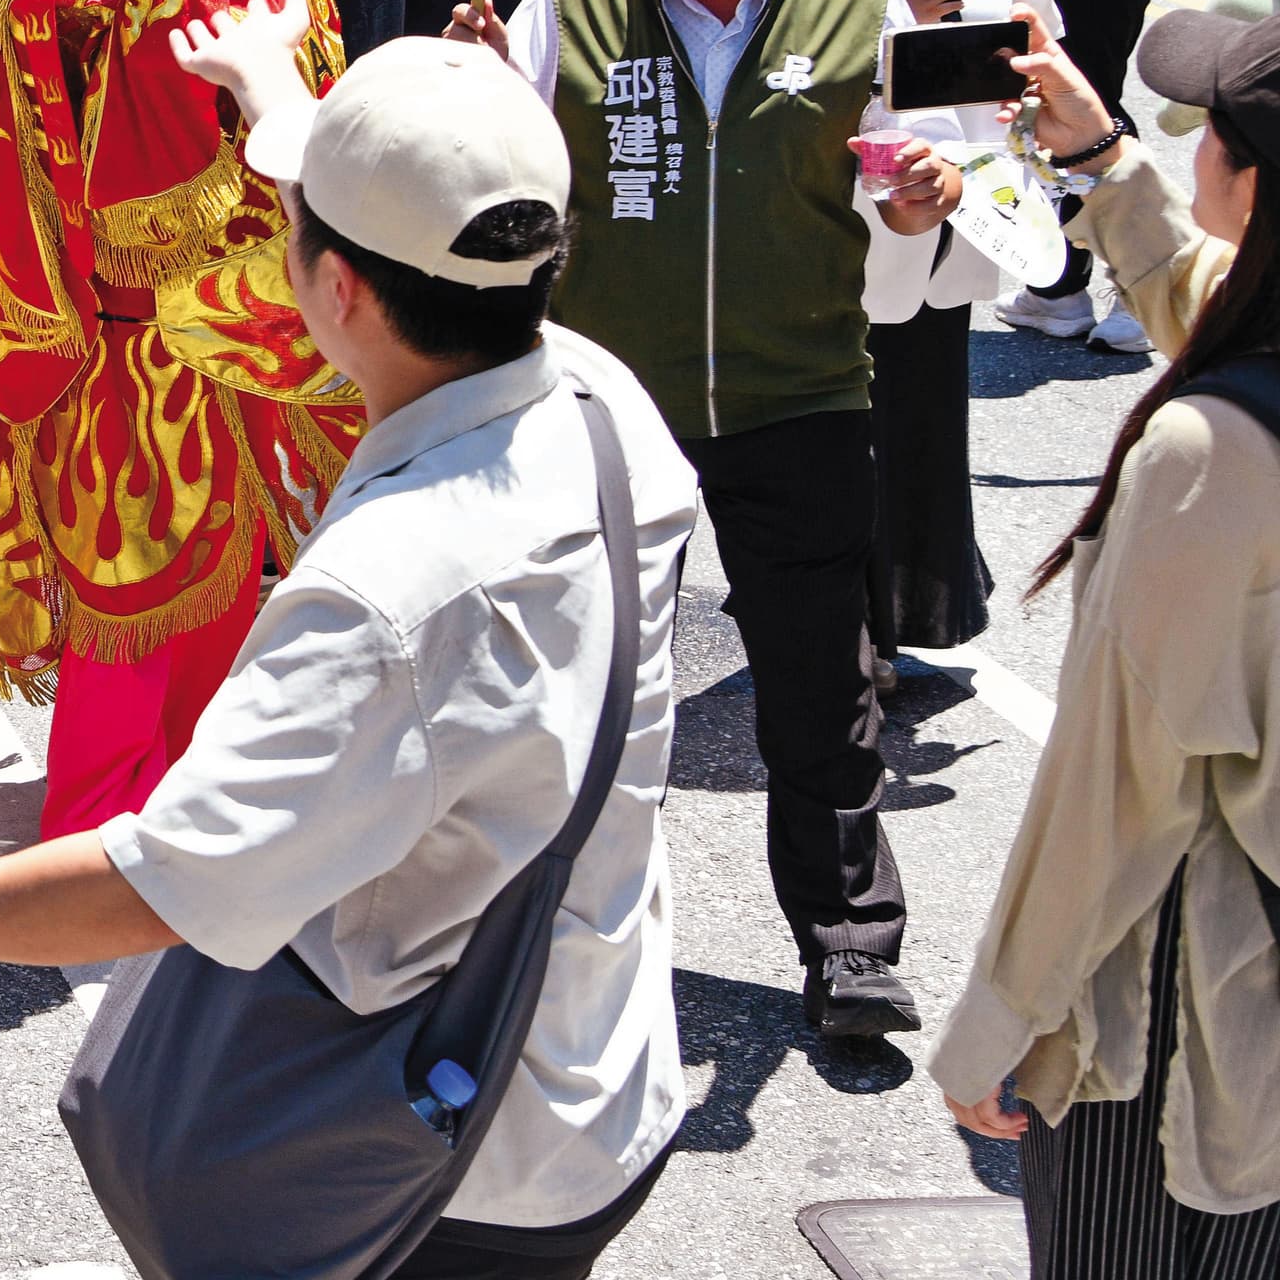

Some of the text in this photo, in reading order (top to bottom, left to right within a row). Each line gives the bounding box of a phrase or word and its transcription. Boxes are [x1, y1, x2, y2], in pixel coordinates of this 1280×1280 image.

[603, 58, 659, 222] 邱建富
[656, 55, 680, 136] 宗教委員會
